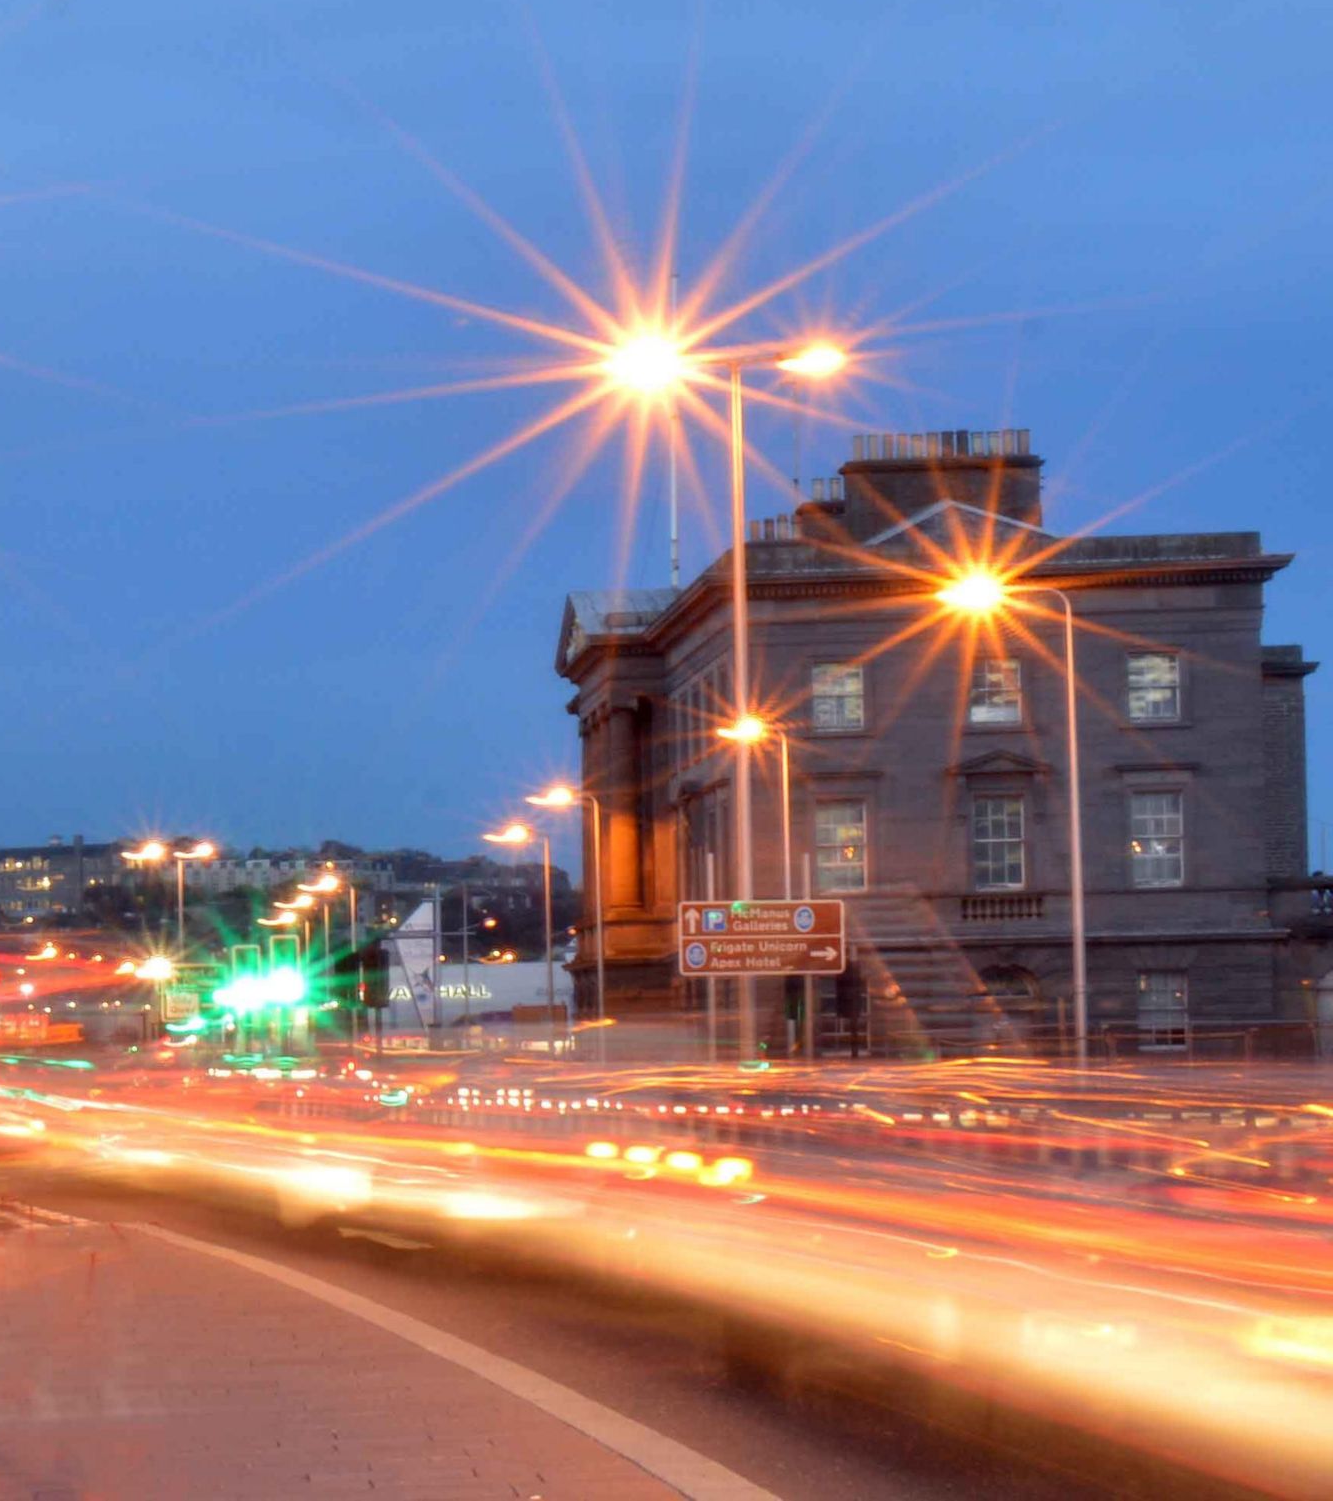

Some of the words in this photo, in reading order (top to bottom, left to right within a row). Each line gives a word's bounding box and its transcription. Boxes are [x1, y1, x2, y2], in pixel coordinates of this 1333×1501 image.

[731, 907, 790, 919] McManus
[732, 921, 789, 931] Galleries
[710, 942, 754, 954] Frigate
[759, 941, 807, 952] Unicorn
[711, 957, 741, 969] Apex
[746, 956, 781, 967] Hotel
